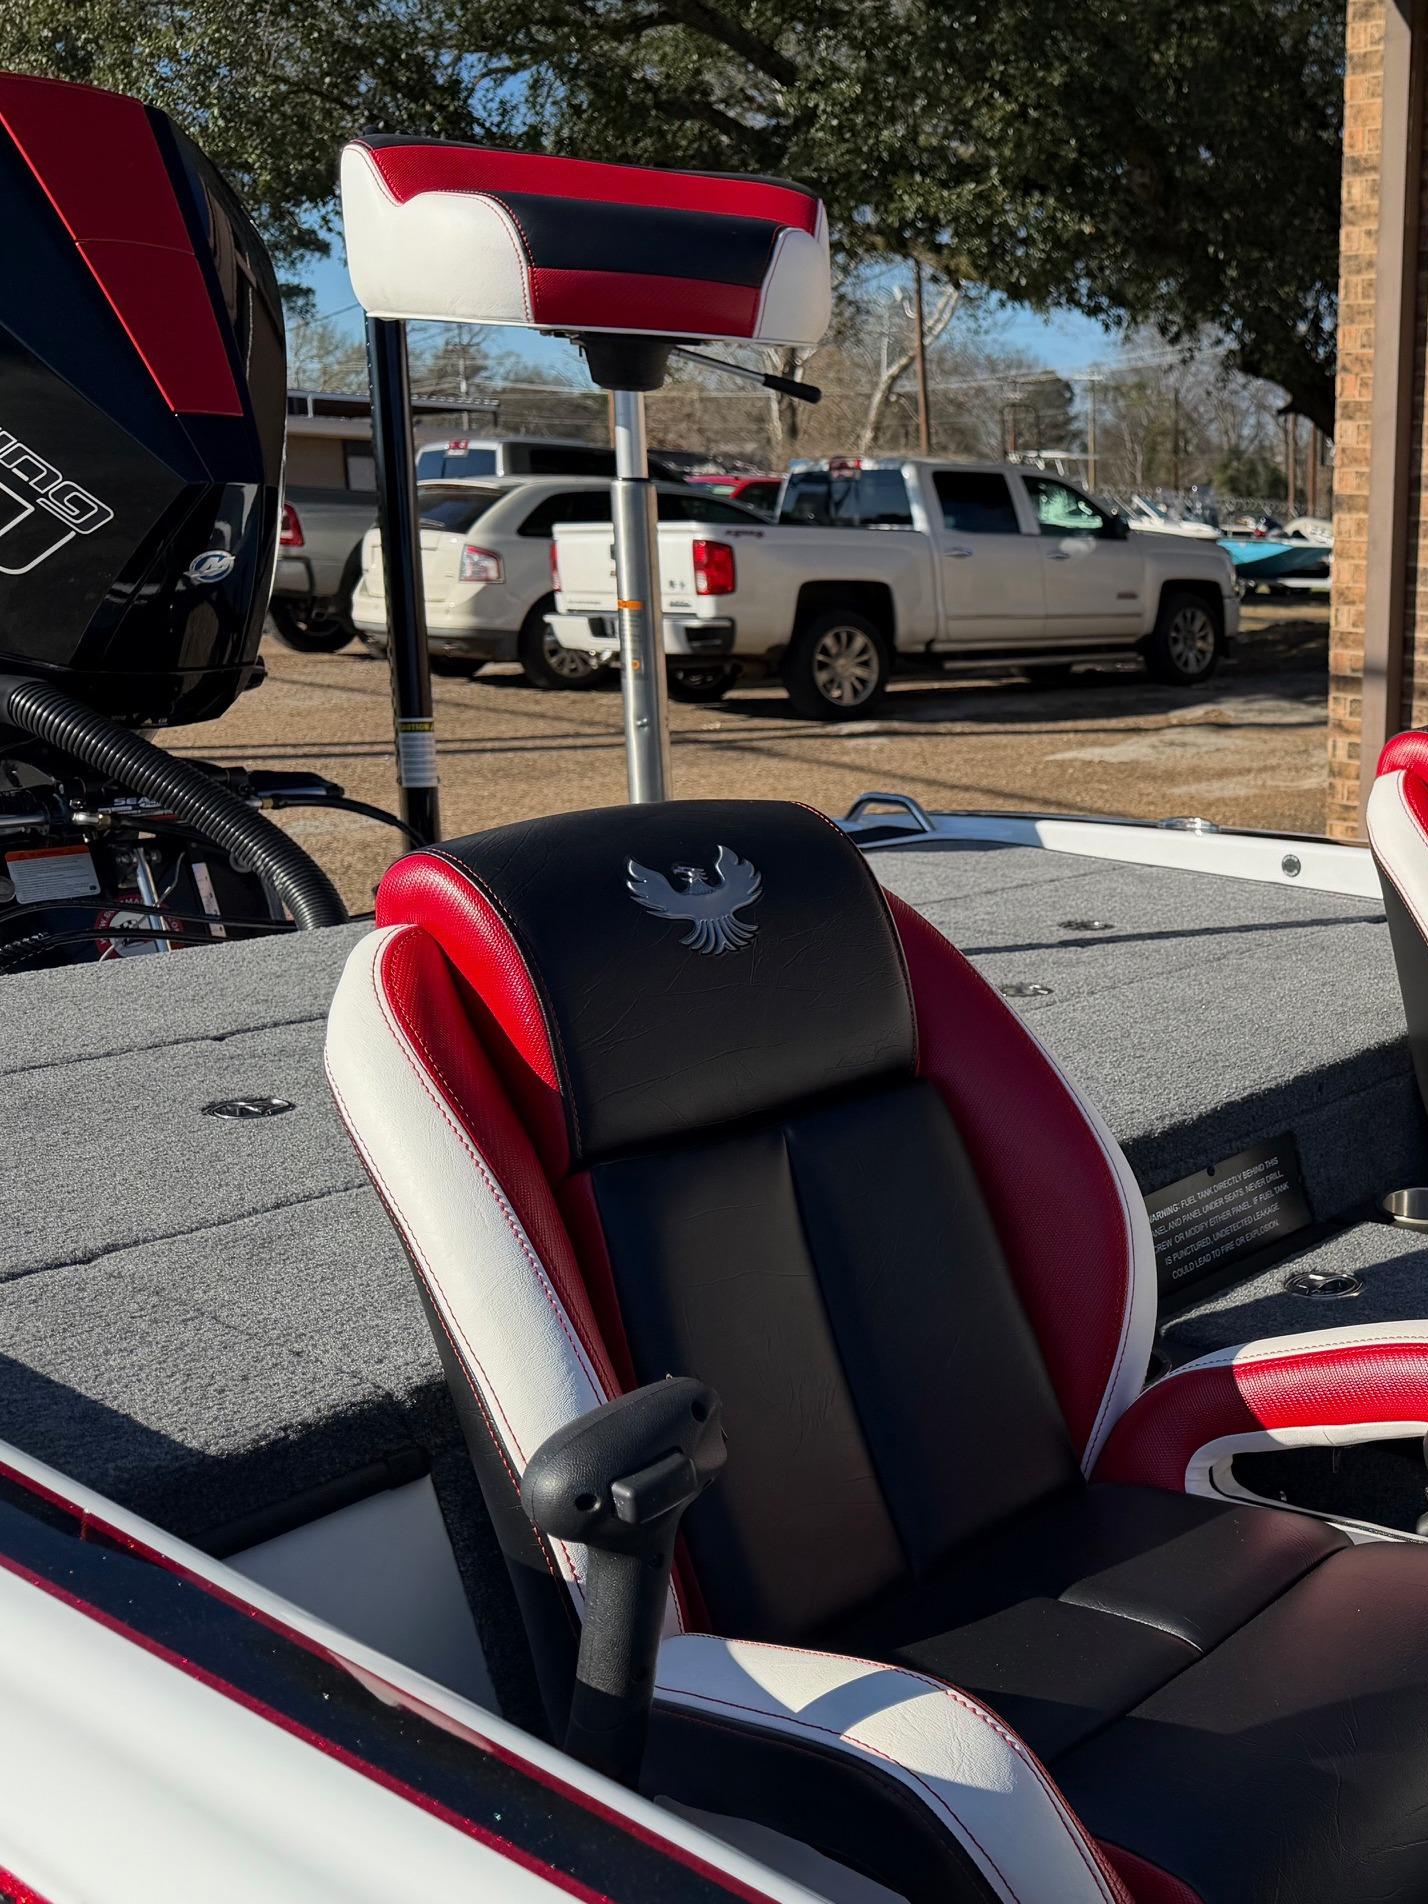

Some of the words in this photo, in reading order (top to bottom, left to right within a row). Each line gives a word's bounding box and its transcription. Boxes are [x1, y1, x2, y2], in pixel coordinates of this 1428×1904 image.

[1152, 1225, 1168, 1238] ANEL
[1168, 1217, 1183, 1231] AND
[1182, 1208, 1203, 1224] PANEL
[1202, 1197, 1225, 1214] UNDER
[1244, 1178, 1266, 1193] NEVER
[1181, 1195, 1197, 1208] FUEL
[1197, 1187, 1214, 1200] TANK
[1213, 1173, 1242, 1193] DIRECTLY
[1242, 1163, 1265, 1180] BEHIND
[1264, 1156, 1279, 1169] THIS
[1165, 1256, 1173, 1266] IS
[1212, 1215, 1254, 1241] UNDETECTED
[1252, 1202, 1280, 1222] LEAKAGE
[1174, 1233, 1185, 1244] OR
[1185, 1221, 1209, 1239] MODIFY
[1209, 1209, 1231, 1227] EITHER
[1252, 1196, 1259, 1206] IF
[1258, 1190, 1275, 1202] FUEL
[1273, 1181, 1289, 1194] TANK
[1172, 1261, 1195, 1279] COULD
[1194, 1253, 1212, 1268] LEAD
[1211, 1248, 1221, 1259] TO
[1220, 1241, 1235, 1254] FIRE
[1235, 1235, 1247, 1247] OR
